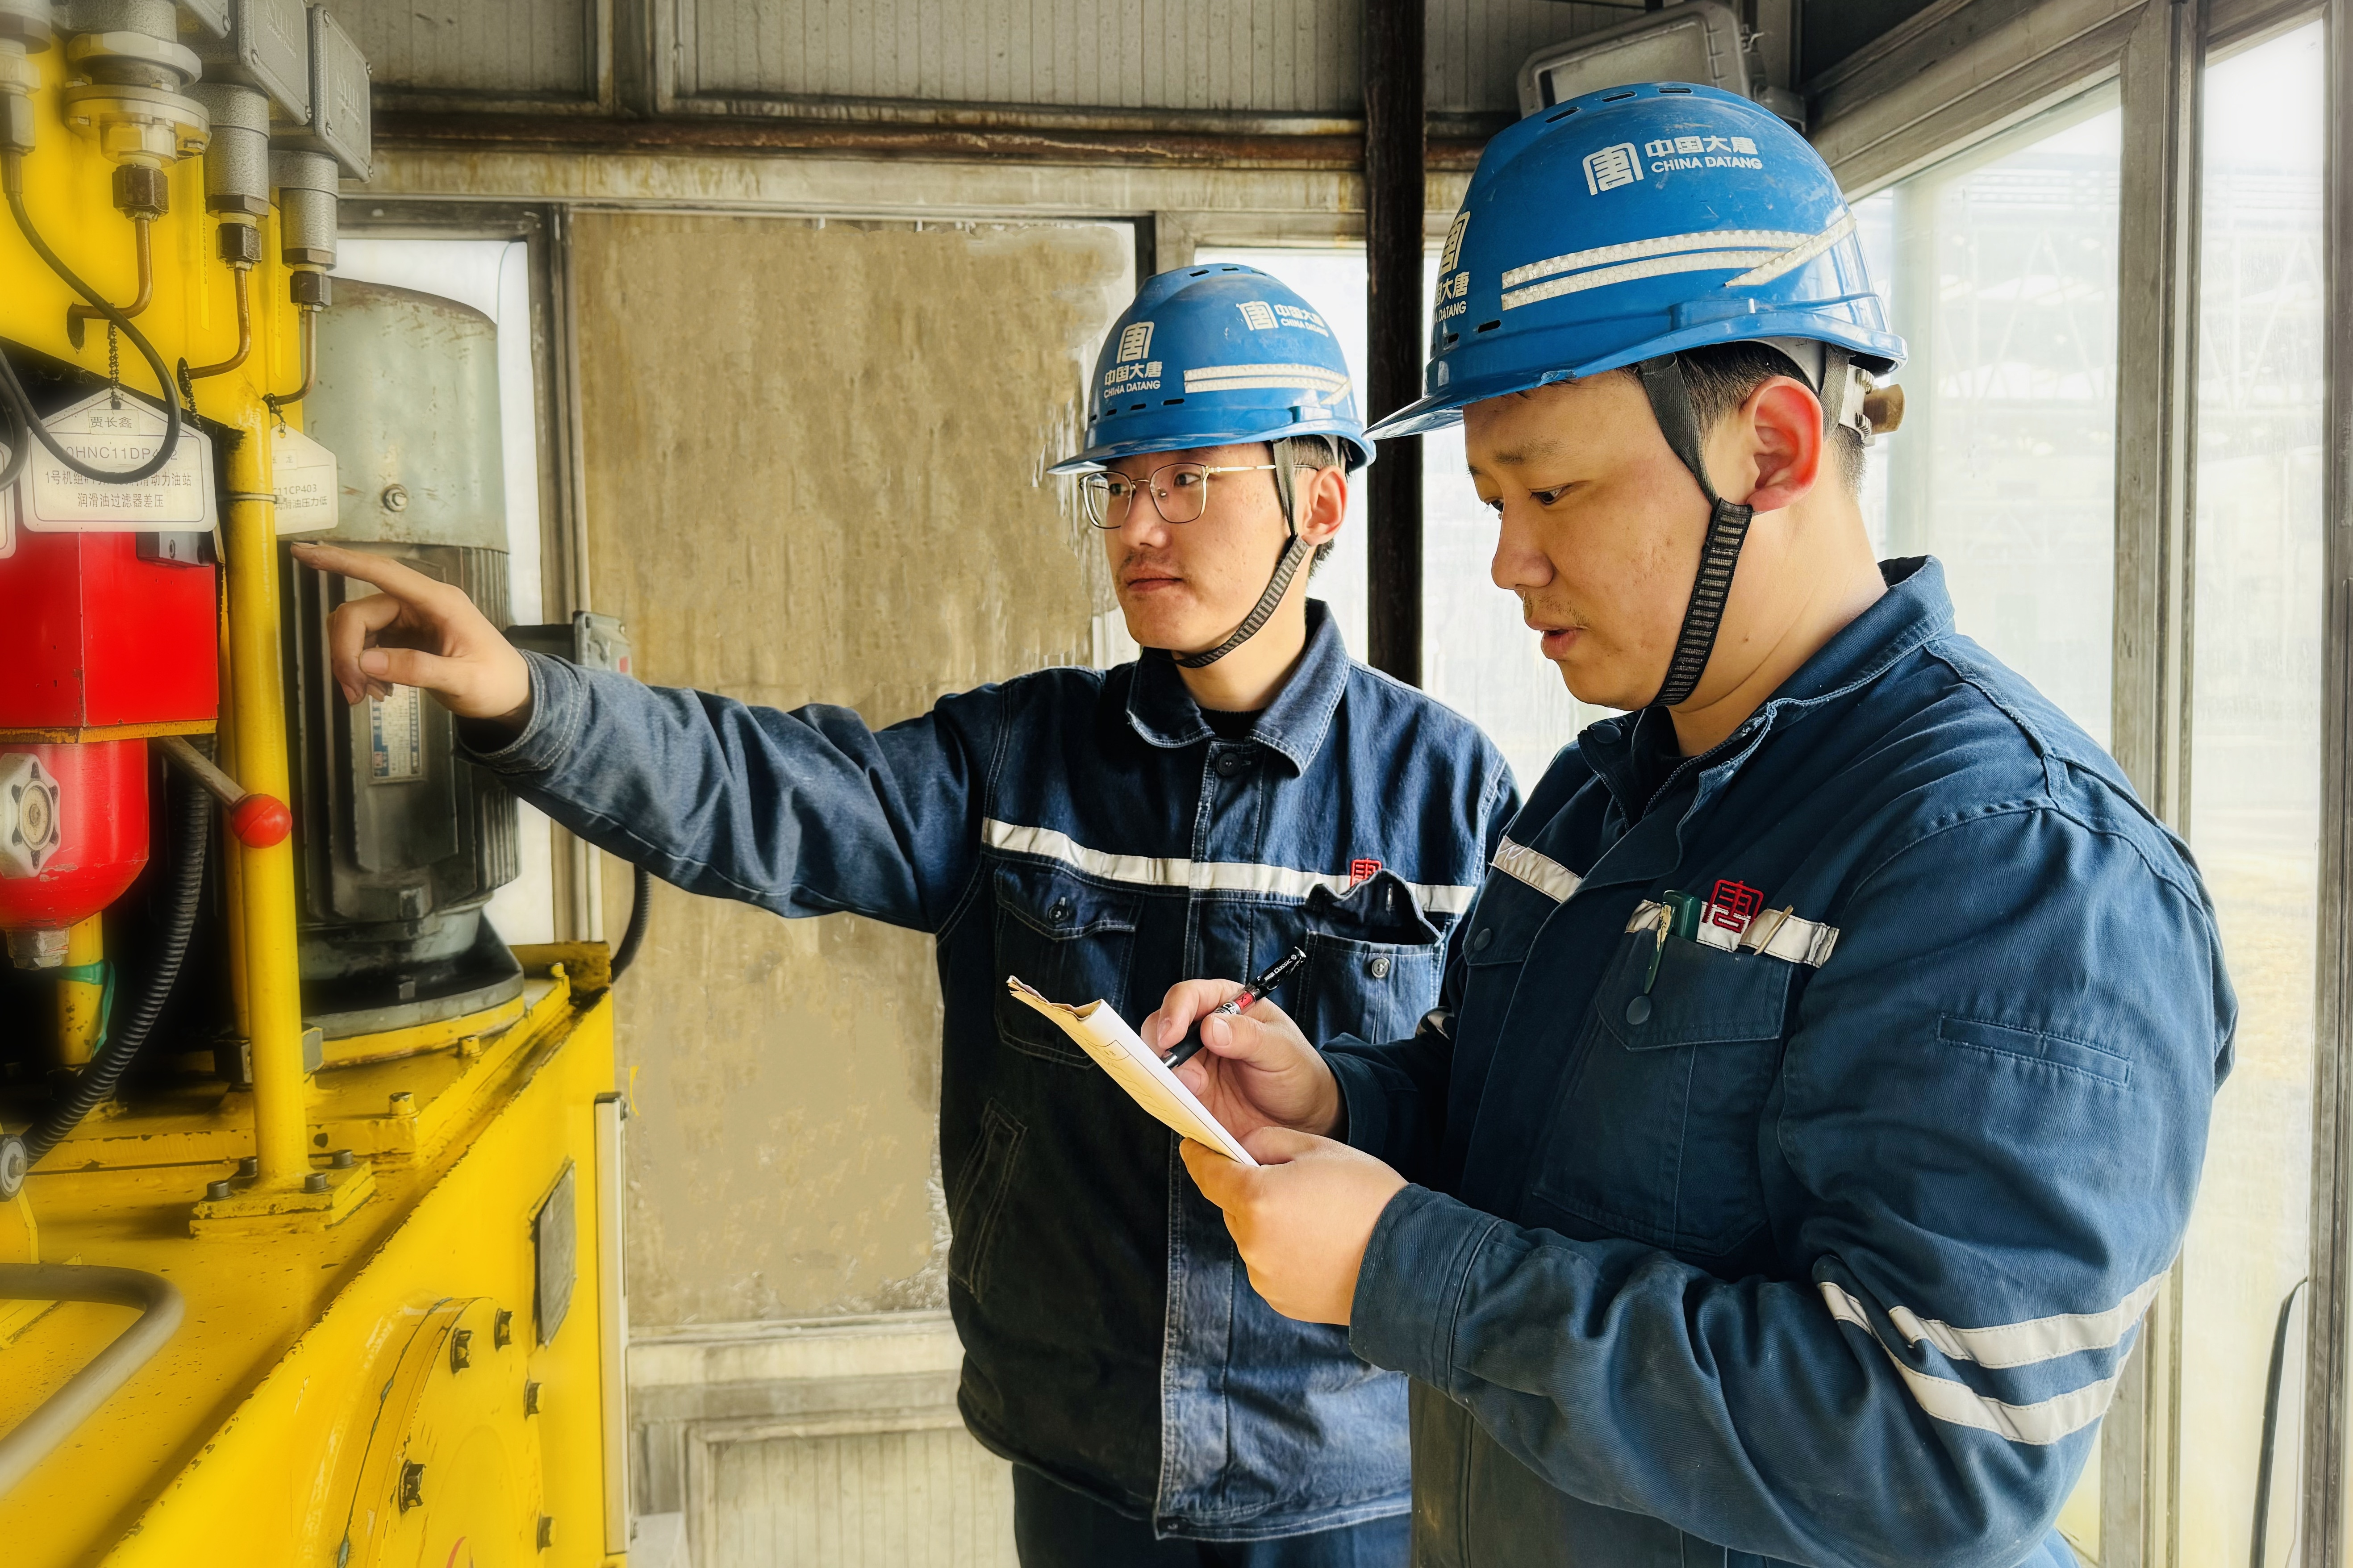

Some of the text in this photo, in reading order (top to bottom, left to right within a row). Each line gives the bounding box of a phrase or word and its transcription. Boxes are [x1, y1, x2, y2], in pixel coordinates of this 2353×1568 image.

[1644, 135, 1758, 157] 中国大唐
[1651, 156, 1763, 173] CHINA DATANG
[1438, 300, 1466, 322] DATANG
[1104, 361, 1163, 386] 中国大唐
[1104, 379, 1161, 399] CHINA DATANG
[90, 416, 132, 429] 贾长鑫
[77, 493, 164, 508] 润滑油过滤器差压
